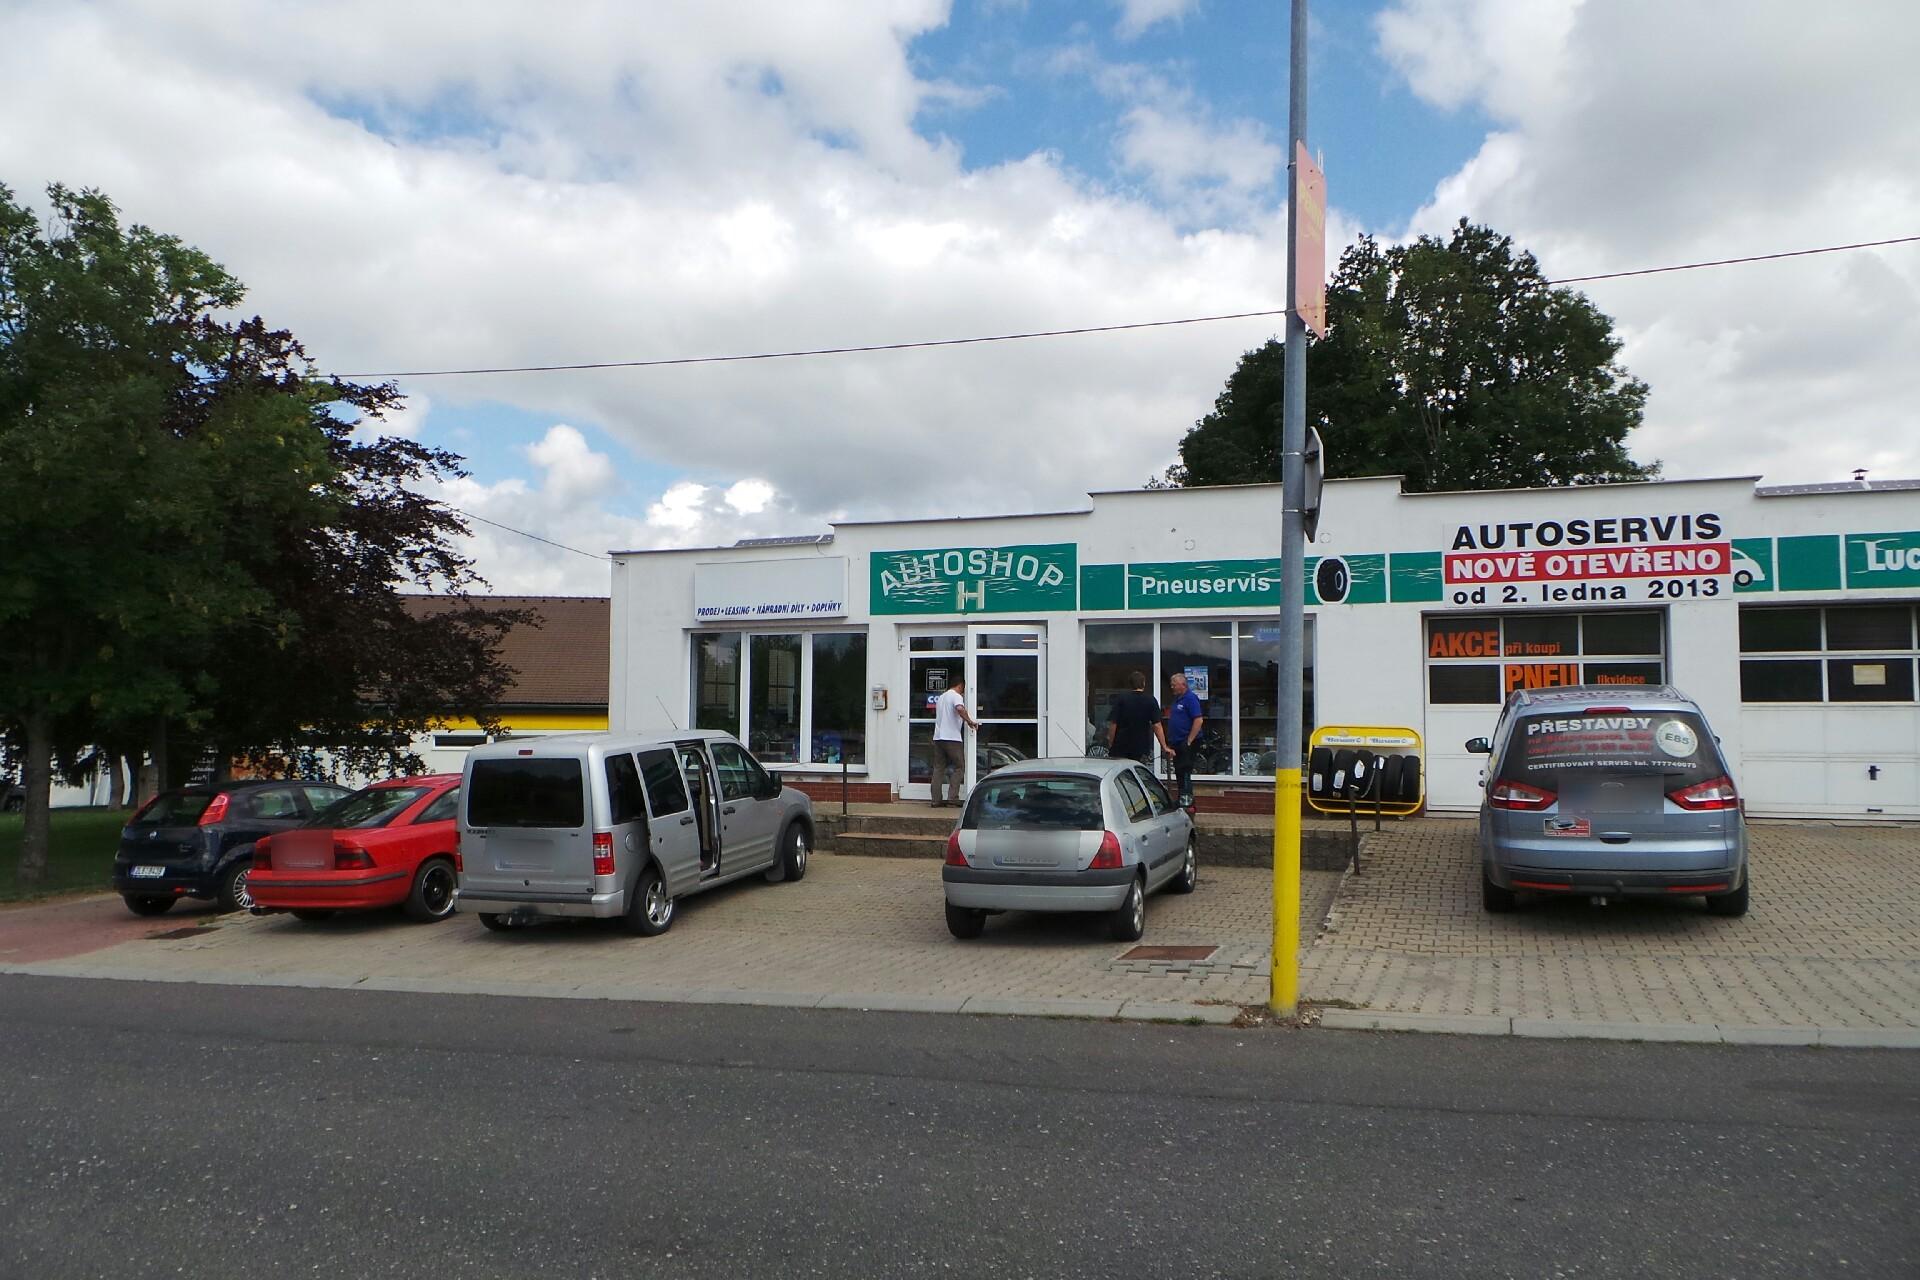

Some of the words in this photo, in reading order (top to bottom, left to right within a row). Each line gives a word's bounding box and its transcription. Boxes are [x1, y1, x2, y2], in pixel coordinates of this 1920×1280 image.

[1452, 513, 1722, 550] AUTOSERVIS
[880, 550, 1064, 597] AUTOSHOP
[1453, 552, 1536, 579] NOVĚ
[1545, 548, 1721, 576] OTEVŘENO
[956, 579, 985, 610] H
[1141, 572, 1271, 595] Pneuservis
[1453, 587, 1486, 605] od
[1502, 585, 1528, 603] 2.
[1542, 583, 1627, 602] ledna
[1648, 578, 1720, 599] 2013
[697, 607, 720, 617] PRODEJ
[724, 605, 750, 616] LEASING
[756, 602, 790, 615] NÁHRADNÍ
[790, 601, 805, 613] DÍLY
[811, 600, 842, 613] DOPLŇKY
[1430, 631, 1499, 657] AKCE
[1504, 642, 1522, 656] při
[1526, 641, 1561, 655] koupi
[1597, 674, 1646, 684] likvidace
[1528, 717, 1651, 735] PŘESTAVBY
[1665, 733, 1690, 744] E85
